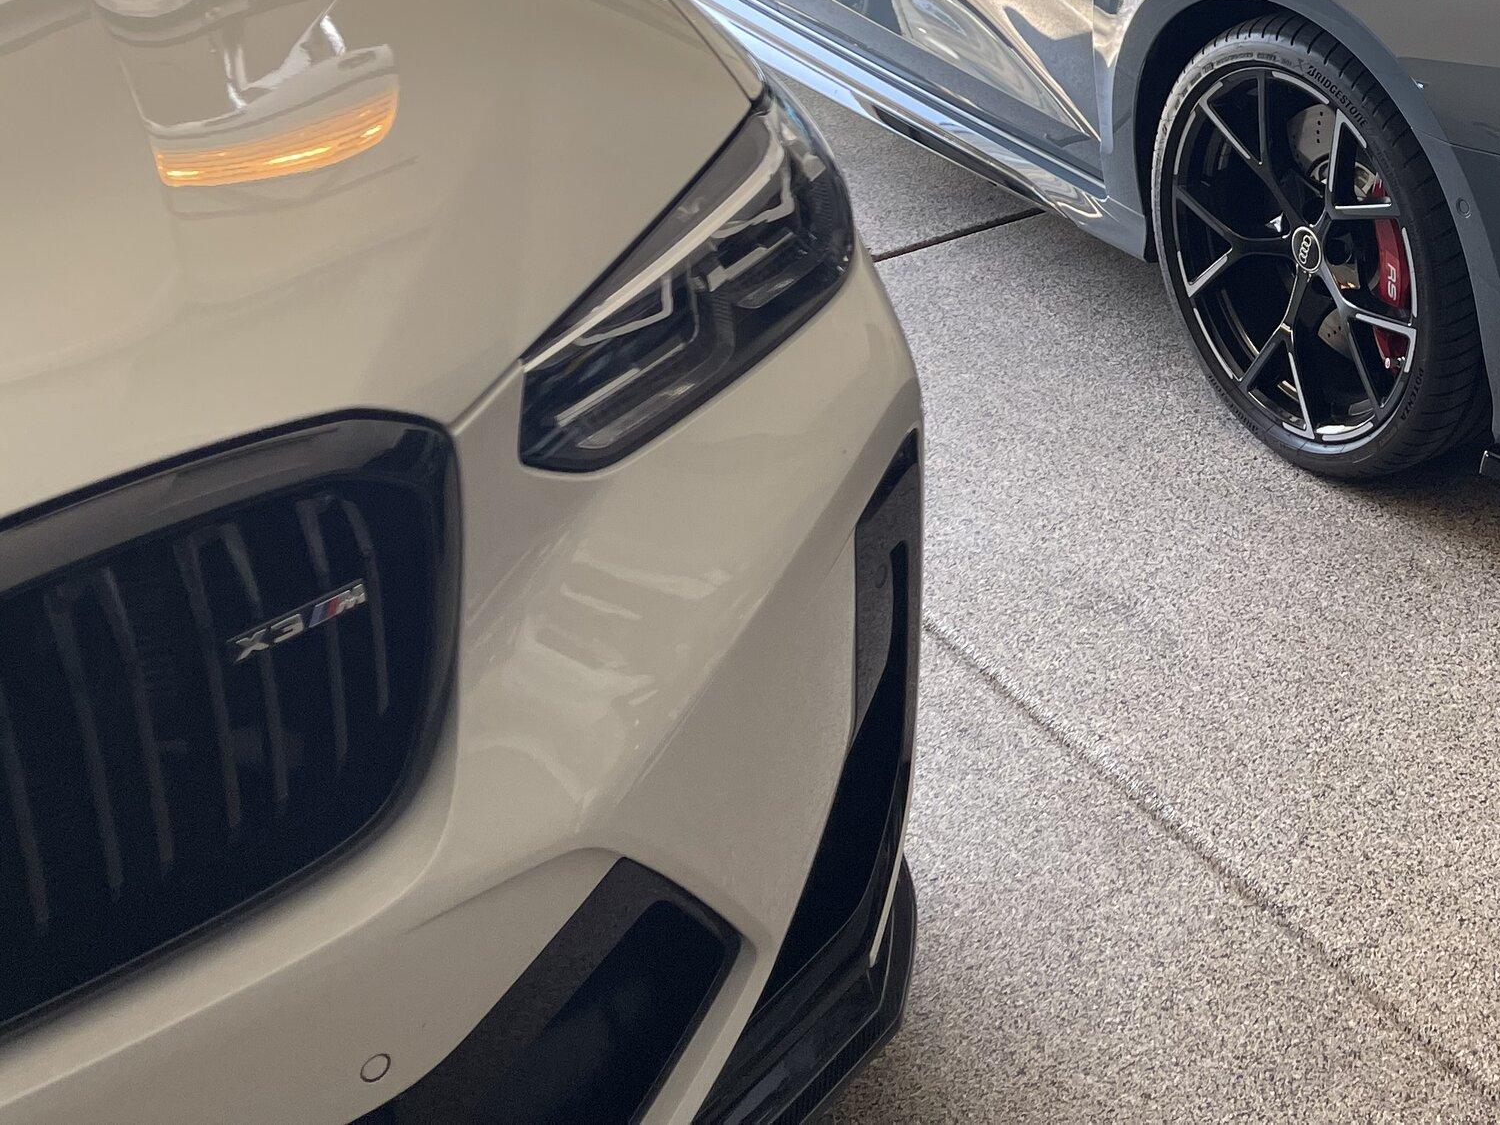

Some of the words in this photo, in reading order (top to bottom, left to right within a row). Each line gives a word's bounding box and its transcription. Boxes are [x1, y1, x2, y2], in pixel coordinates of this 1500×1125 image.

[1306, 64, 1368, 128] BRIDGESTONE
[1386, 261, 1398, 301] RS
[235, 613, 304, 663] X3
